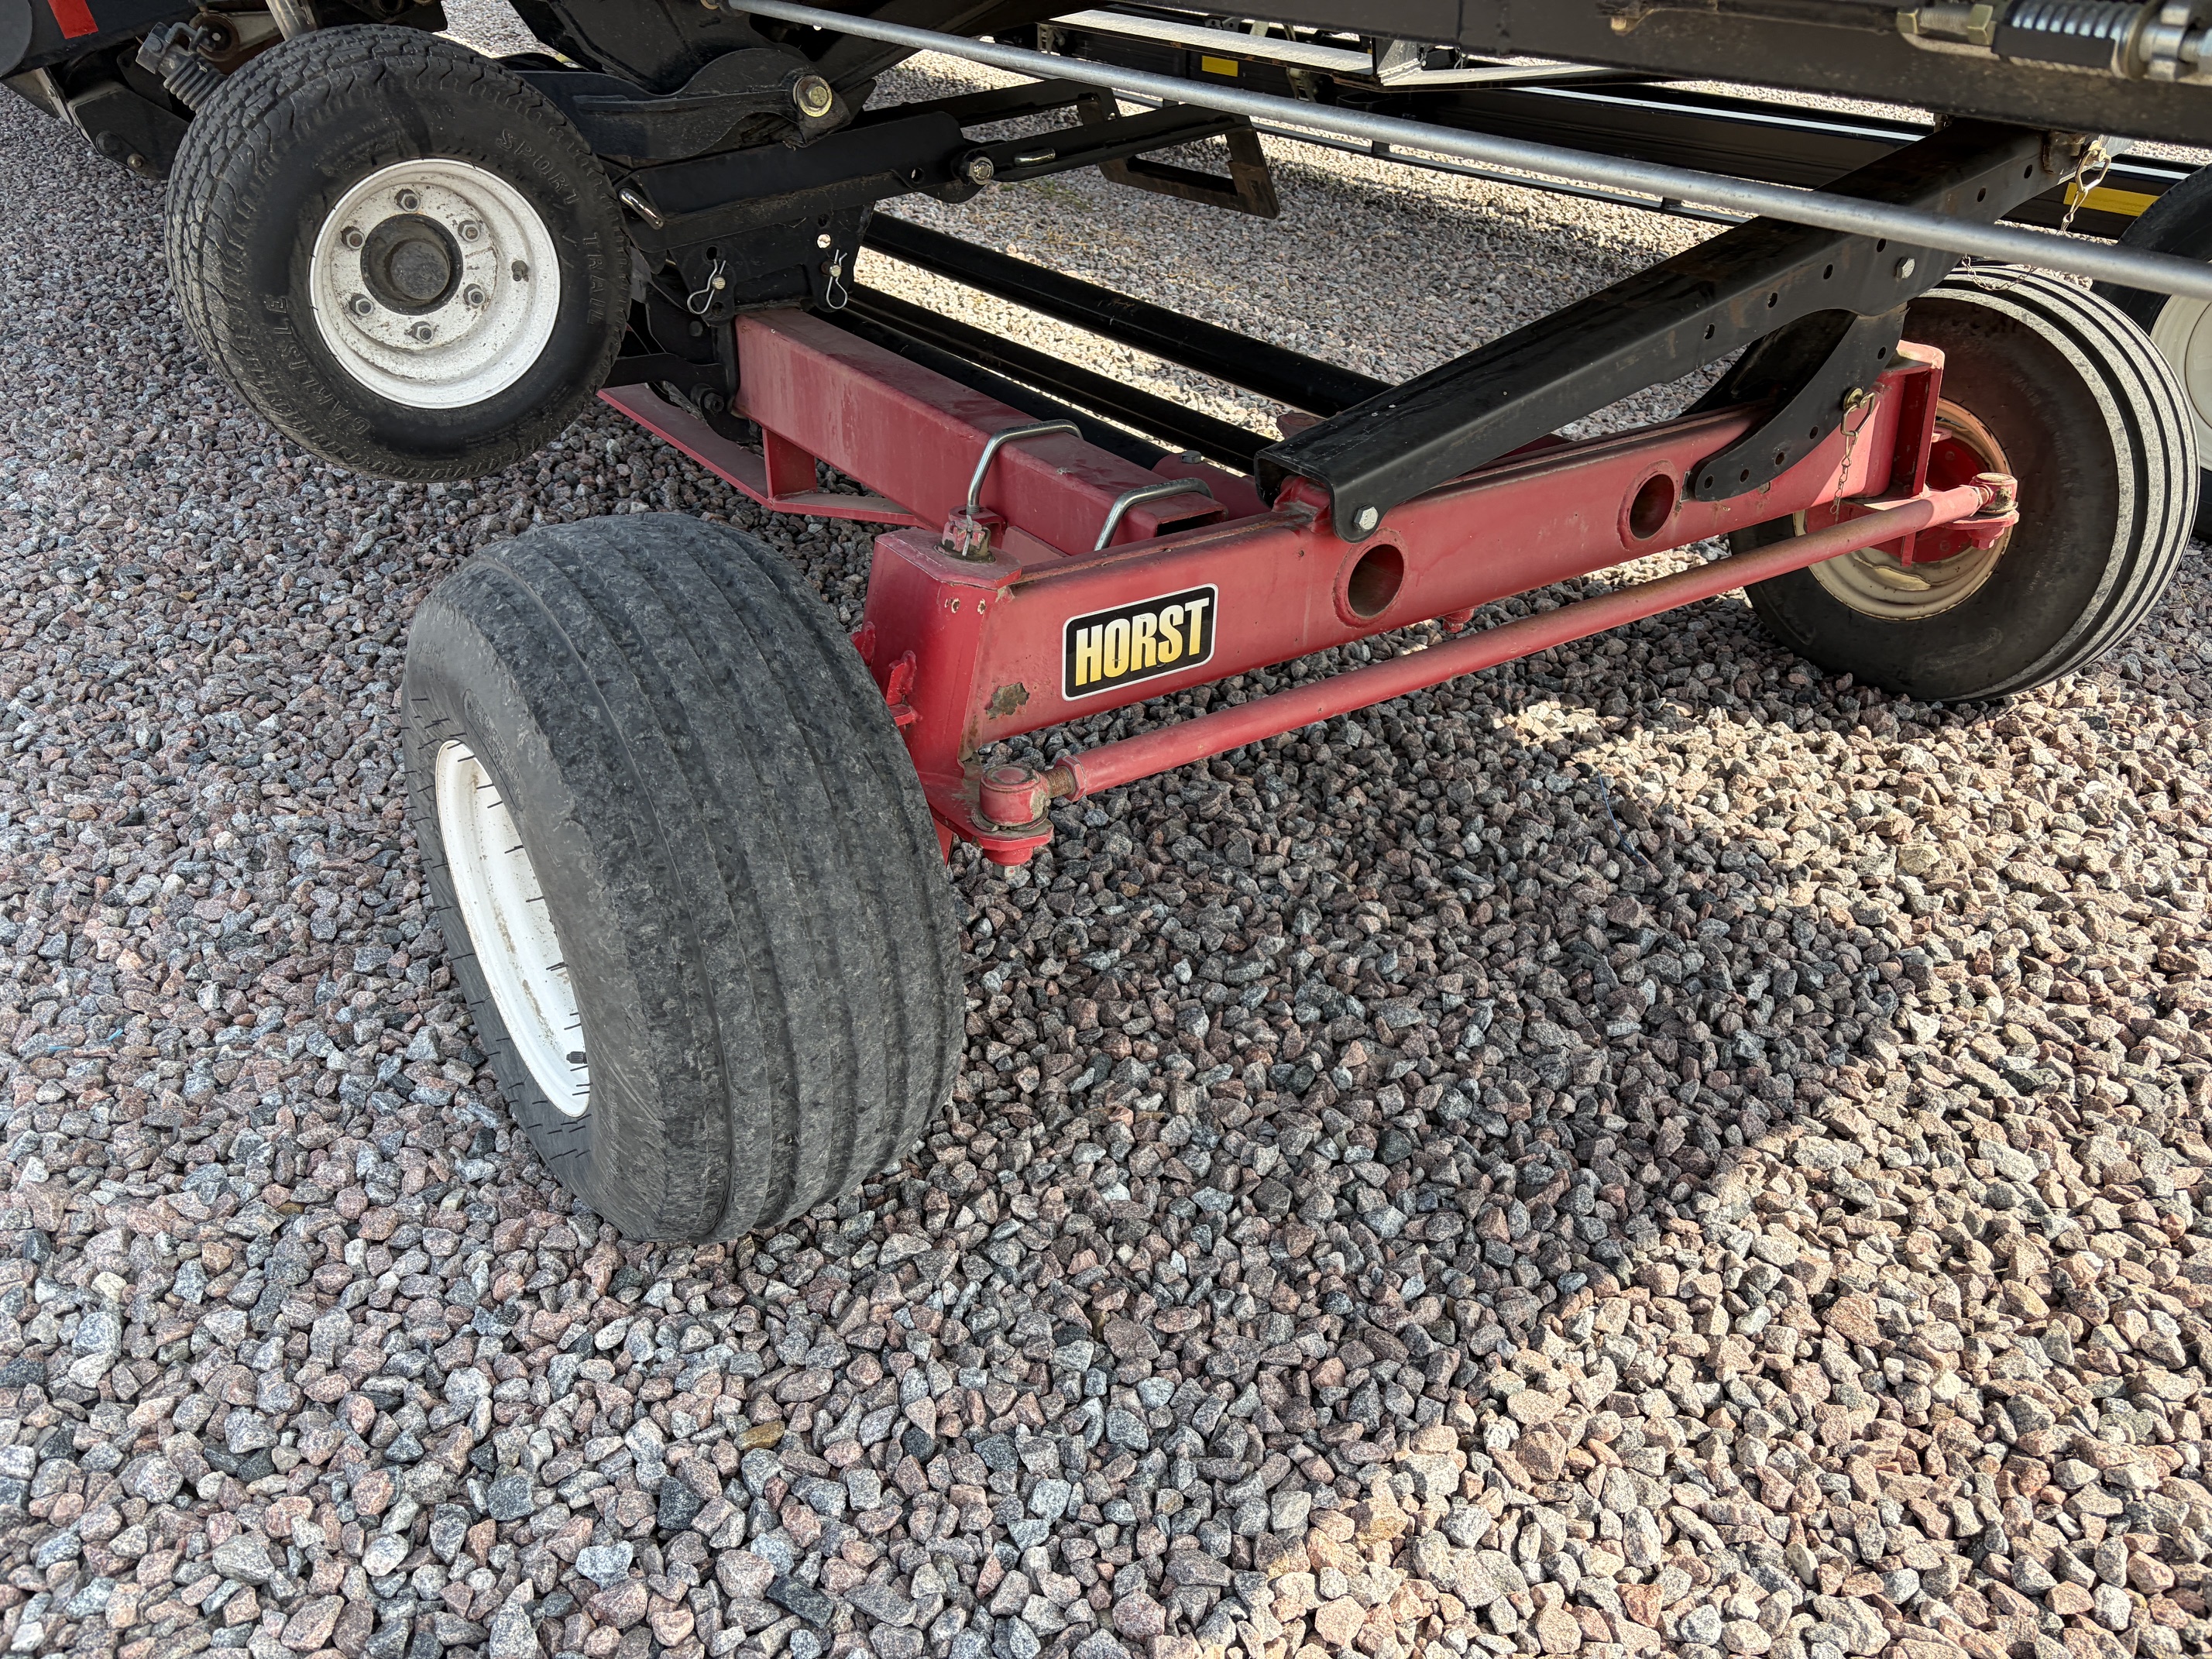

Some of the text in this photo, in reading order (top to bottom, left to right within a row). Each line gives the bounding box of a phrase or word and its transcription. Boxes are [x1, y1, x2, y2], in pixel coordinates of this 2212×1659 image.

[496, 129, 606, 325] SPORT TRAIL
[266, 297, 372, 434] CARLISLE
[1075, 597, 1210, 687] HORST
